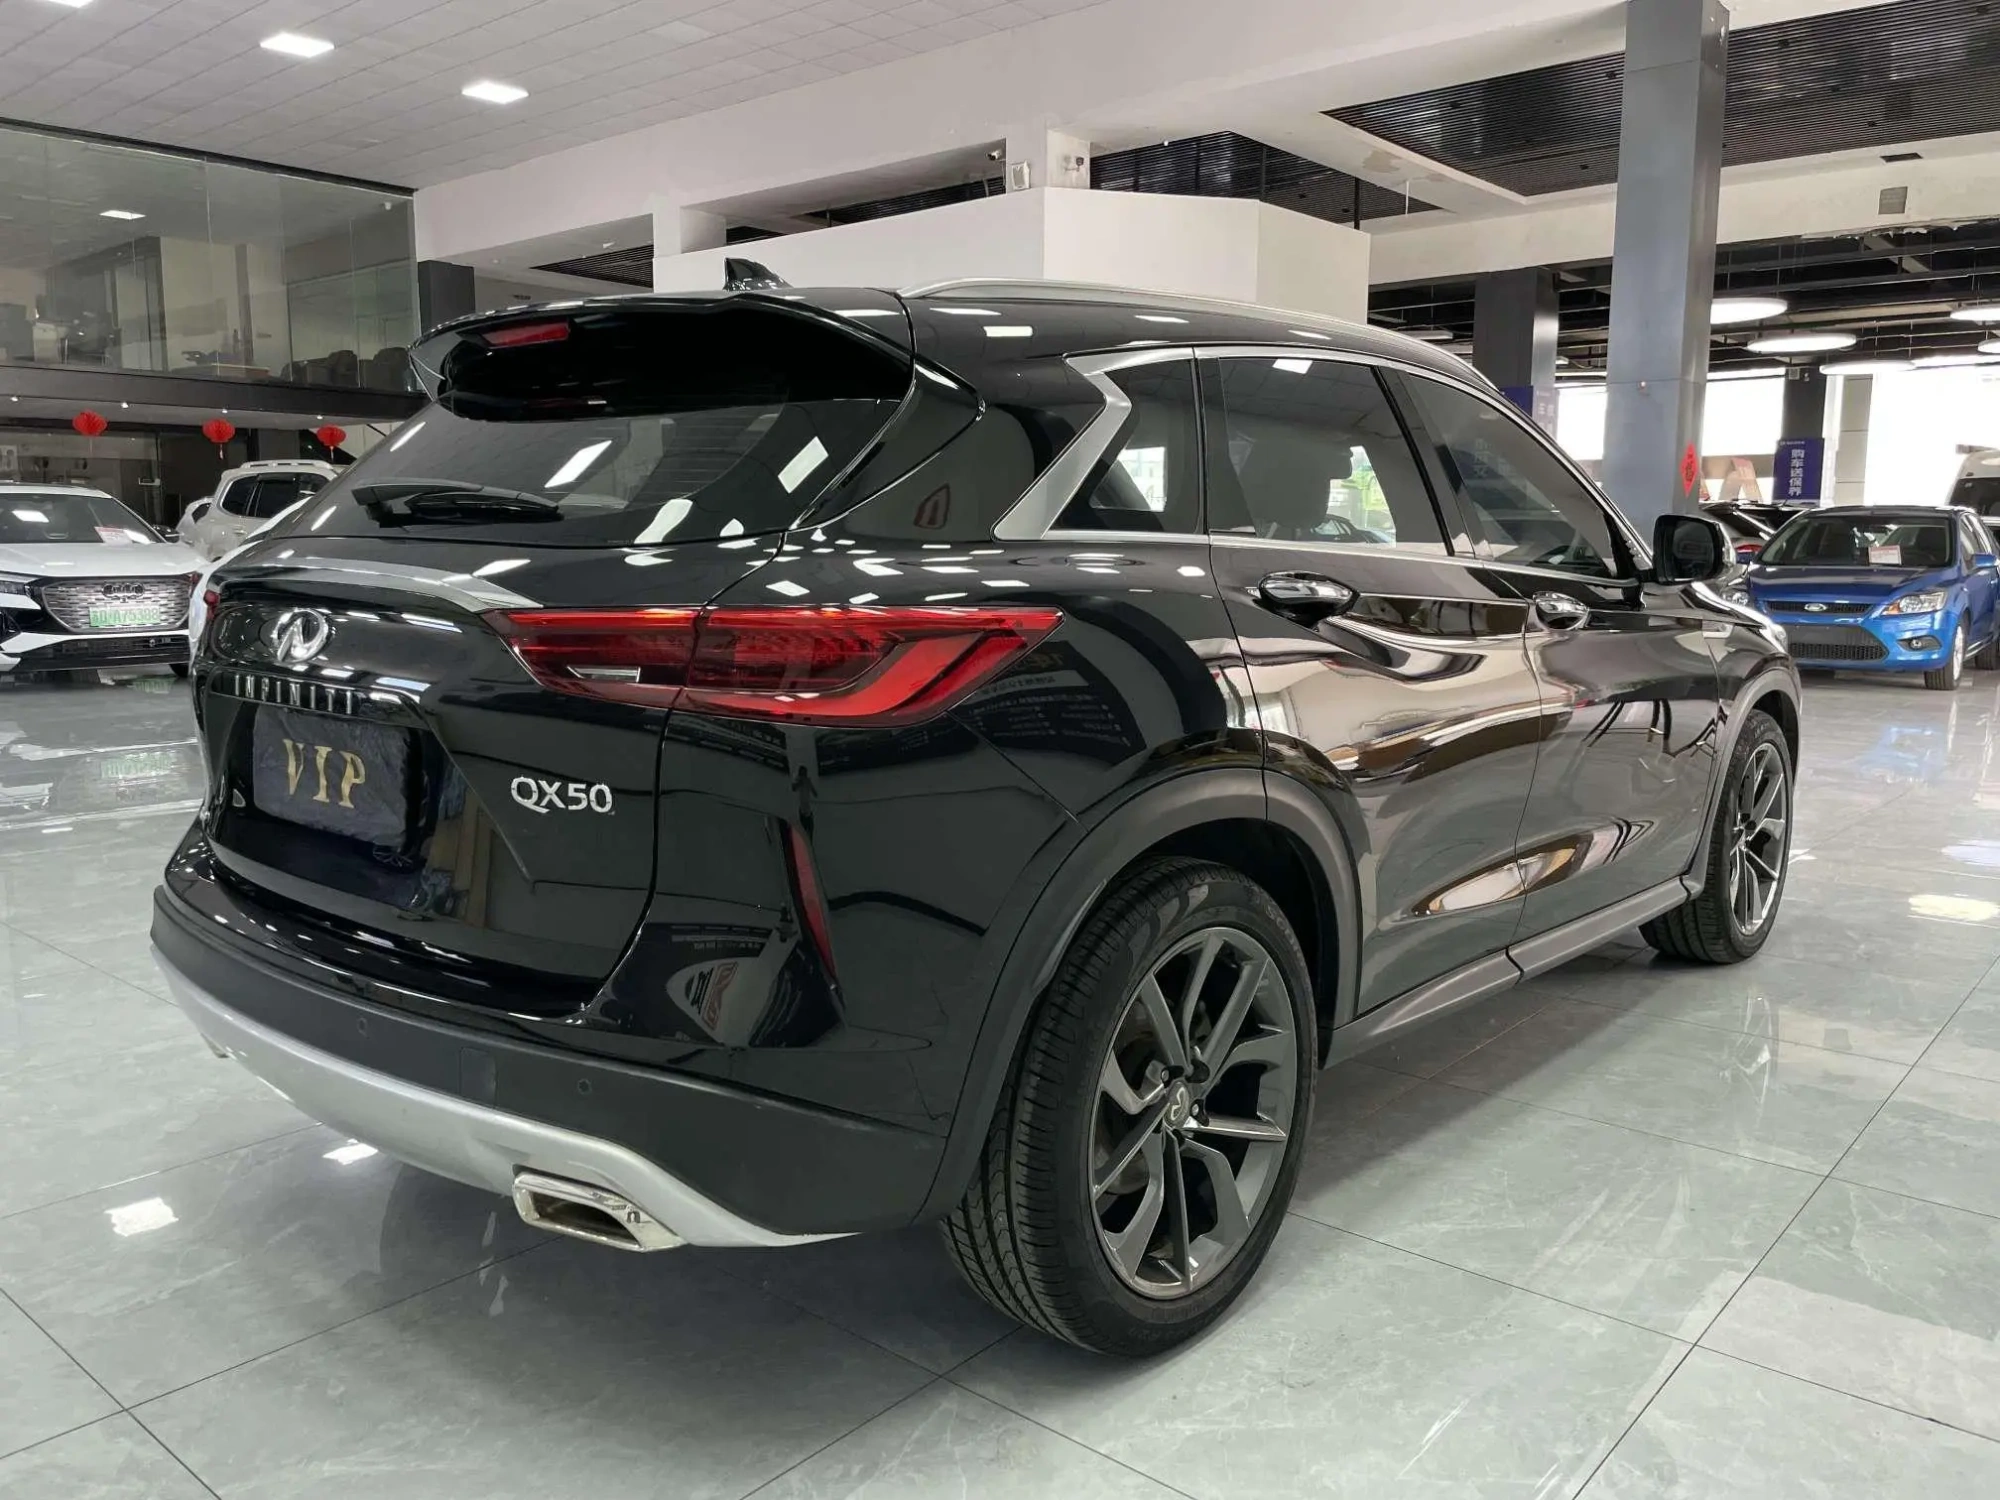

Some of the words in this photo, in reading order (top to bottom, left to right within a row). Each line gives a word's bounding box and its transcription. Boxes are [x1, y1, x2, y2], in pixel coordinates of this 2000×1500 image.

[1788, 449, 1805, 496] 购车送保养
[234, 673, 353, 715] INFINITI
[281, 738, 367, 809] VIP
[510, 775, 614, 814] QX50
